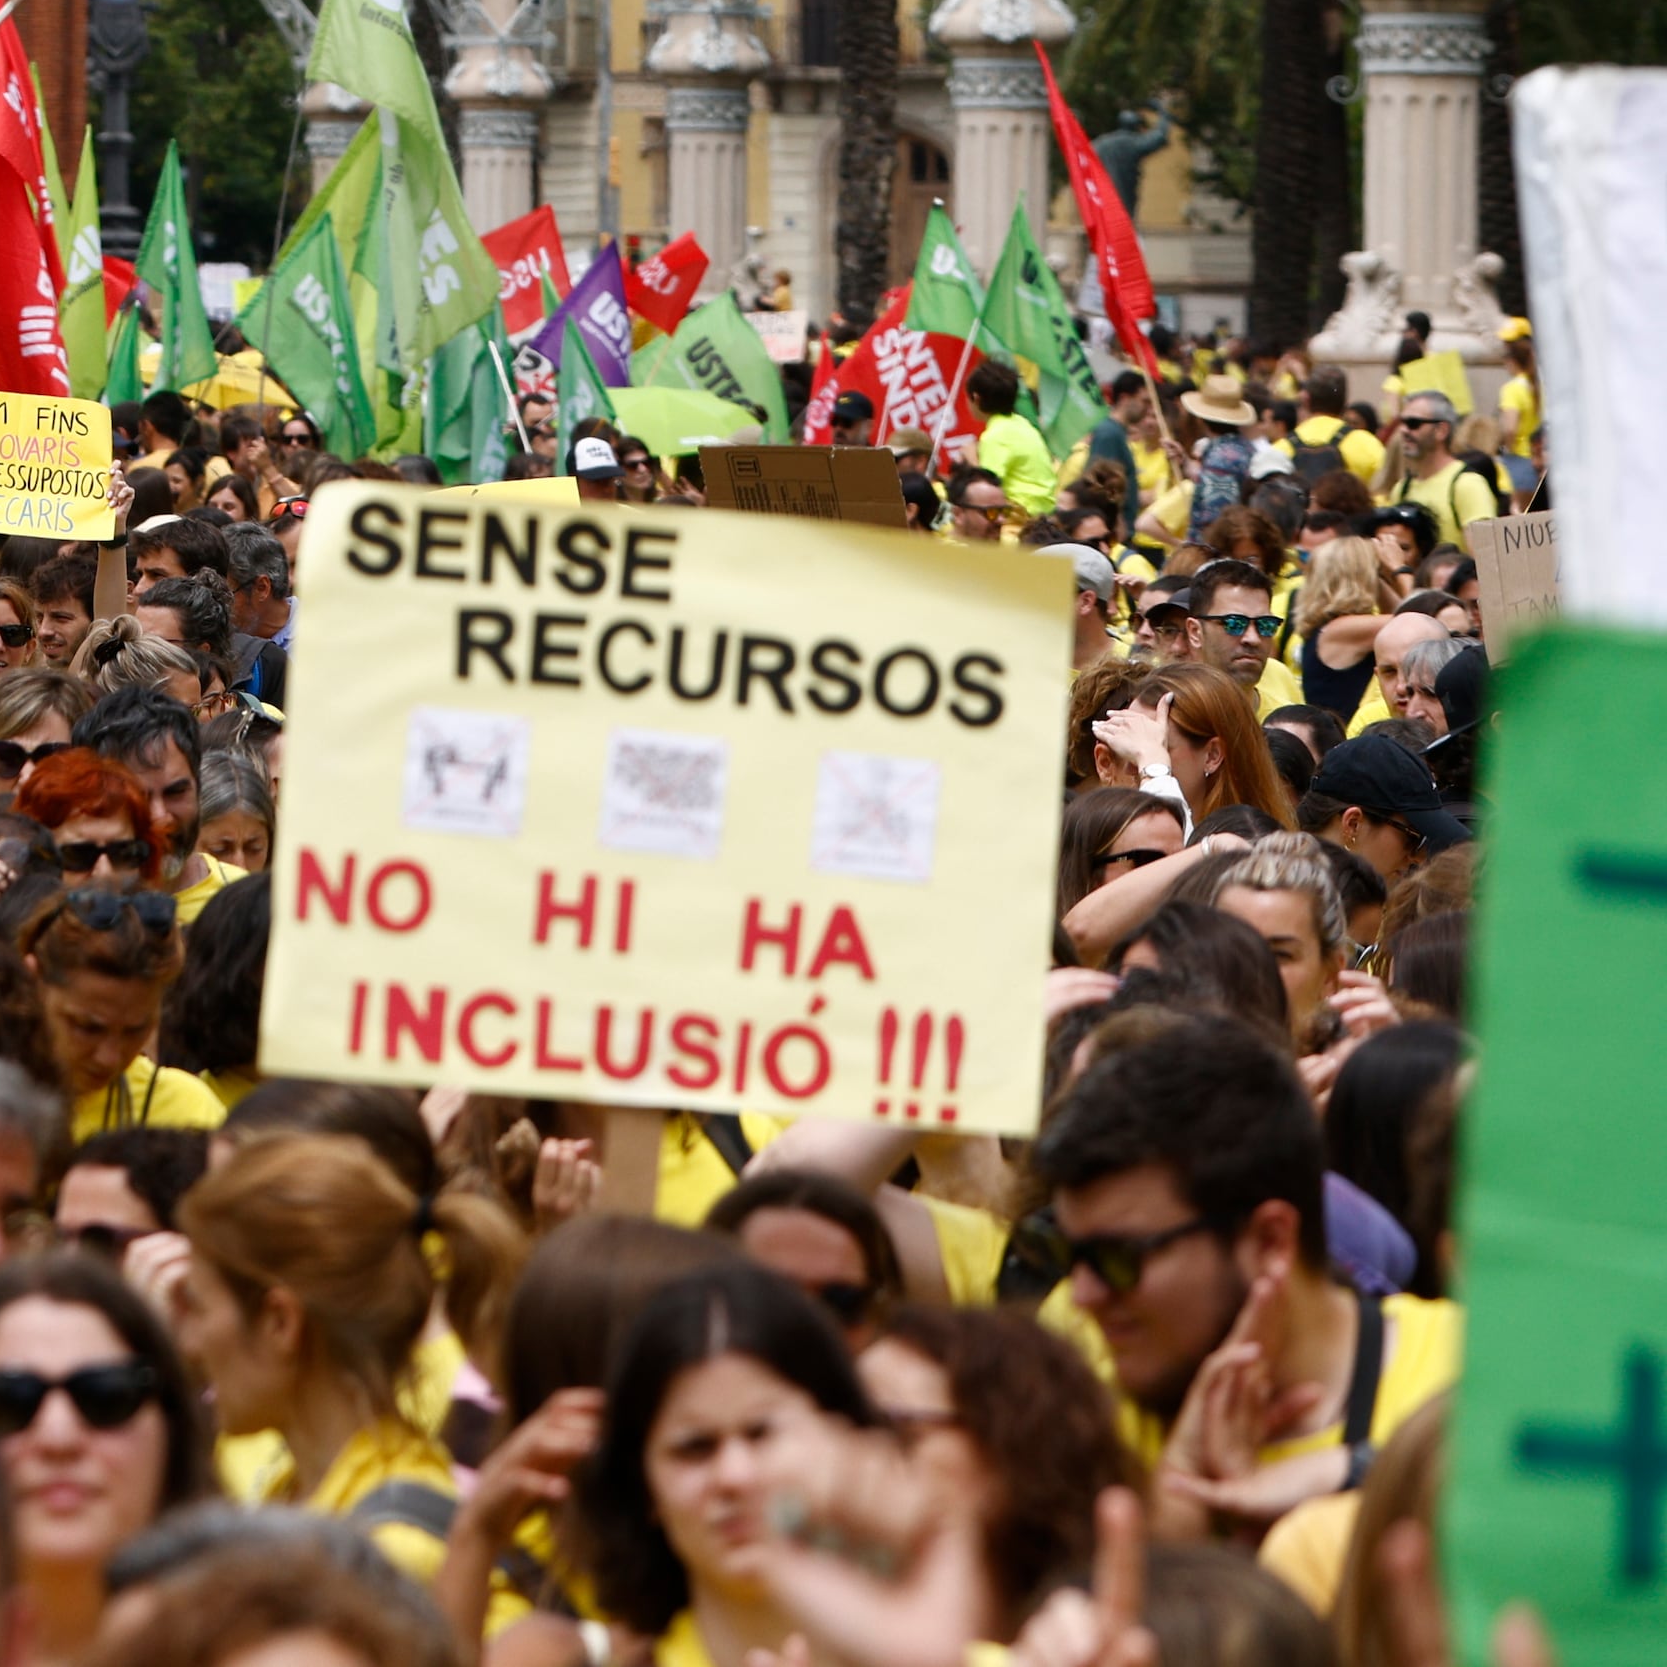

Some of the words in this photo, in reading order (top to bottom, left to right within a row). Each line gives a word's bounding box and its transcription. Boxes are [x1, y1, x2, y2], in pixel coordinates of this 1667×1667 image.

[346, 500, 682, 604] SENSE
[456, 608, 1007, 729] RECURSOS
[294, 846, 434, 936] NO
[531, 868, 637, 954] HI
[736, 895, 879, 983] HA
[348, 980, 834, 1101] INCLUSIÓ
[873, 1004, 967, 1124] !!!
